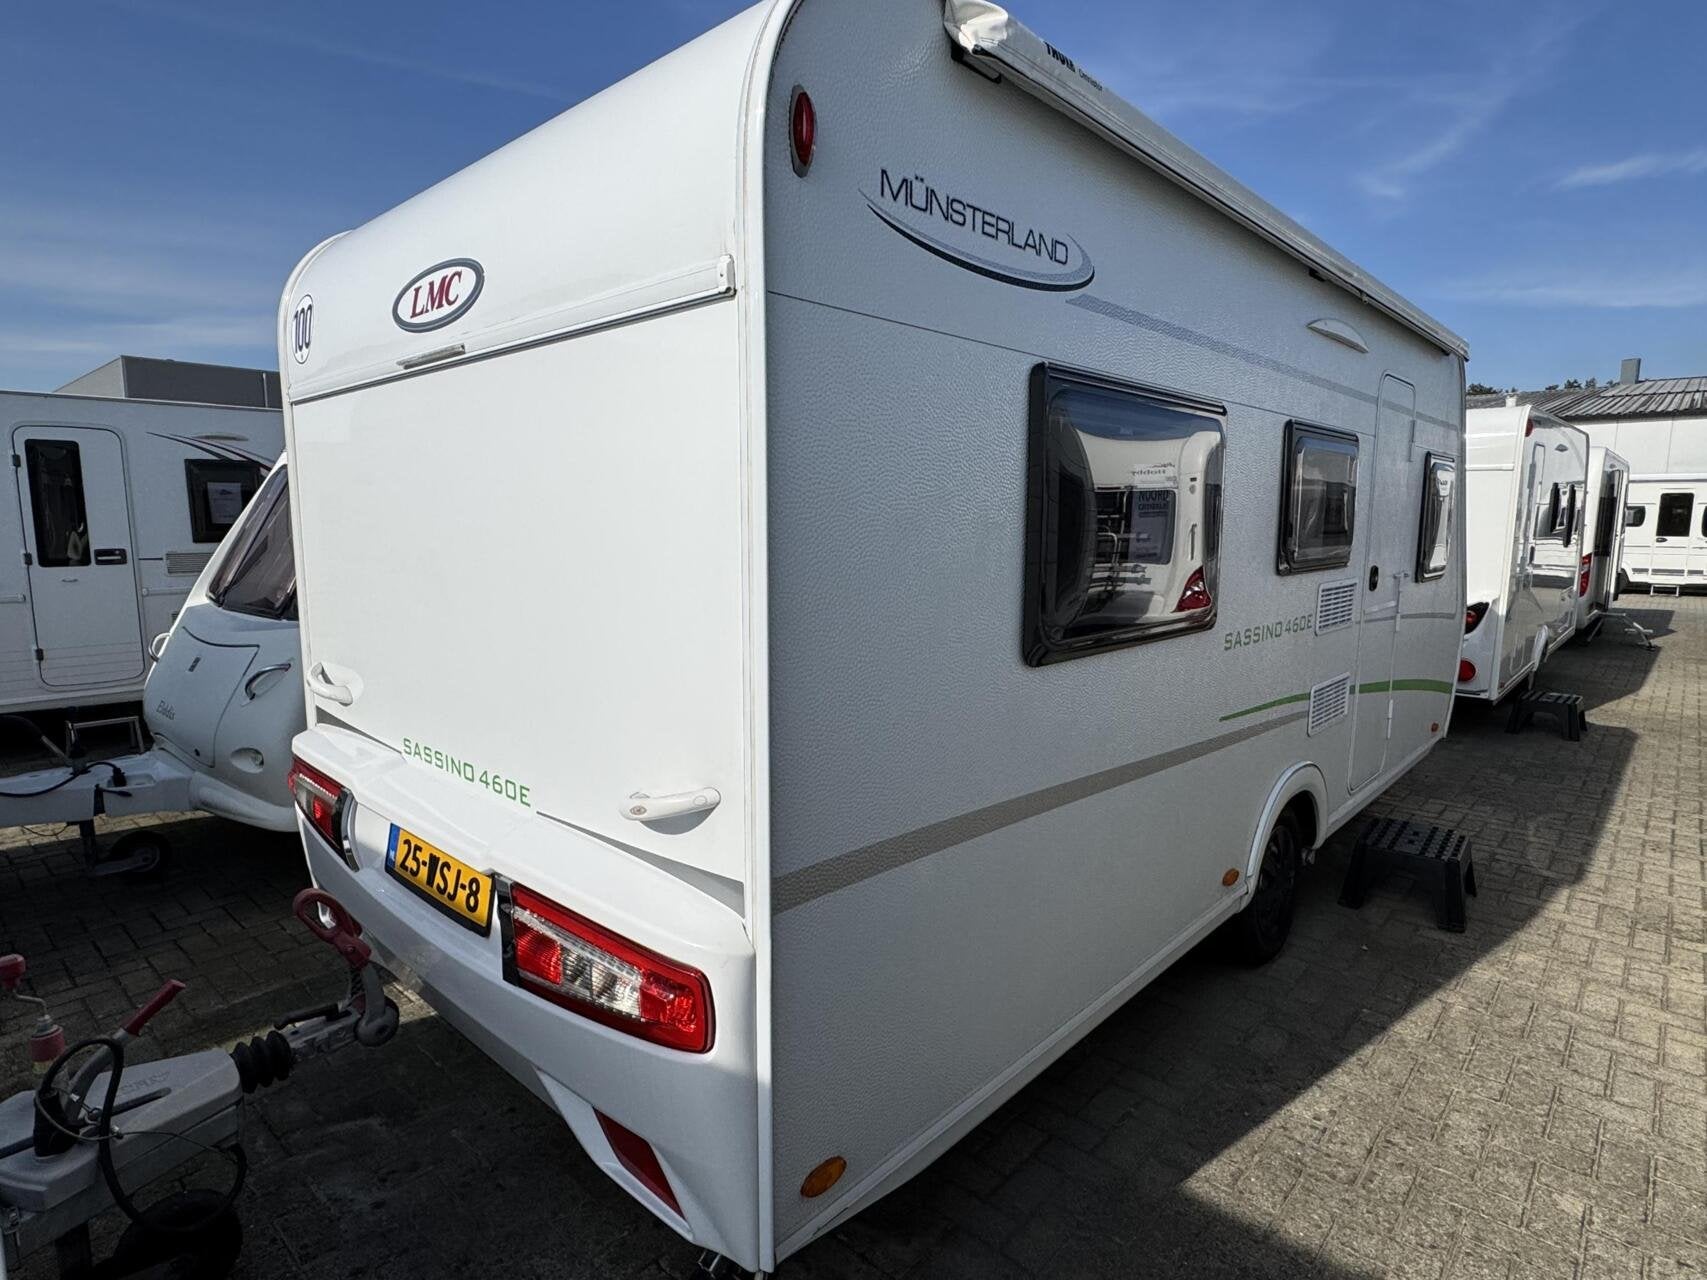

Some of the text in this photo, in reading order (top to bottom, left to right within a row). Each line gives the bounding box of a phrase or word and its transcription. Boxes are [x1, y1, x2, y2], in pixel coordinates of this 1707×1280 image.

[880, 168, 1068, 265] MÜNSTERLAND
[410, 269, 462, 319] LMC
[293, 303, 313, 353] 100
[1224, 614, 1313, 651] SASSINO 460E
[403, 737, 531, 807] SASSINO 460E
[400, 838, 481, 914] 25-WSJ-8
